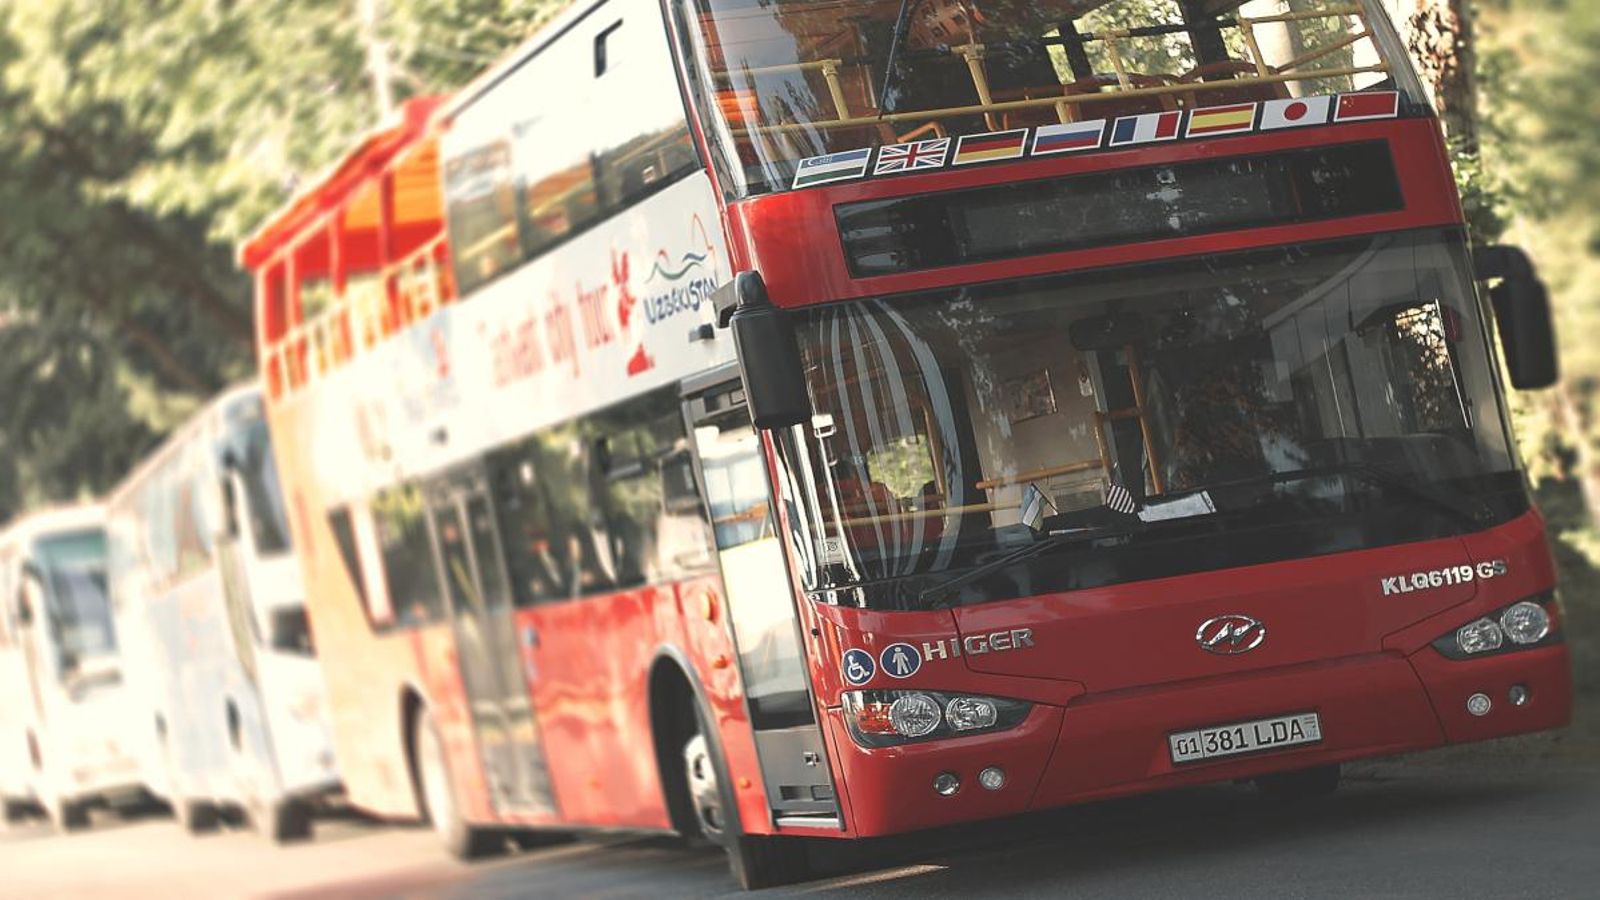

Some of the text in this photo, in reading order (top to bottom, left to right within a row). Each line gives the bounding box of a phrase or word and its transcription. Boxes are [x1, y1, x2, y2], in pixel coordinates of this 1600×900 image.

[1381, 565, 1474, 596] KLQ6119
[922, 628, 1034, 662] HIGER
[1175, 737, 1200, 756] 01
[1203, 727, 1249, 754] 381
[1254, 718, 1305, 746] LDA
